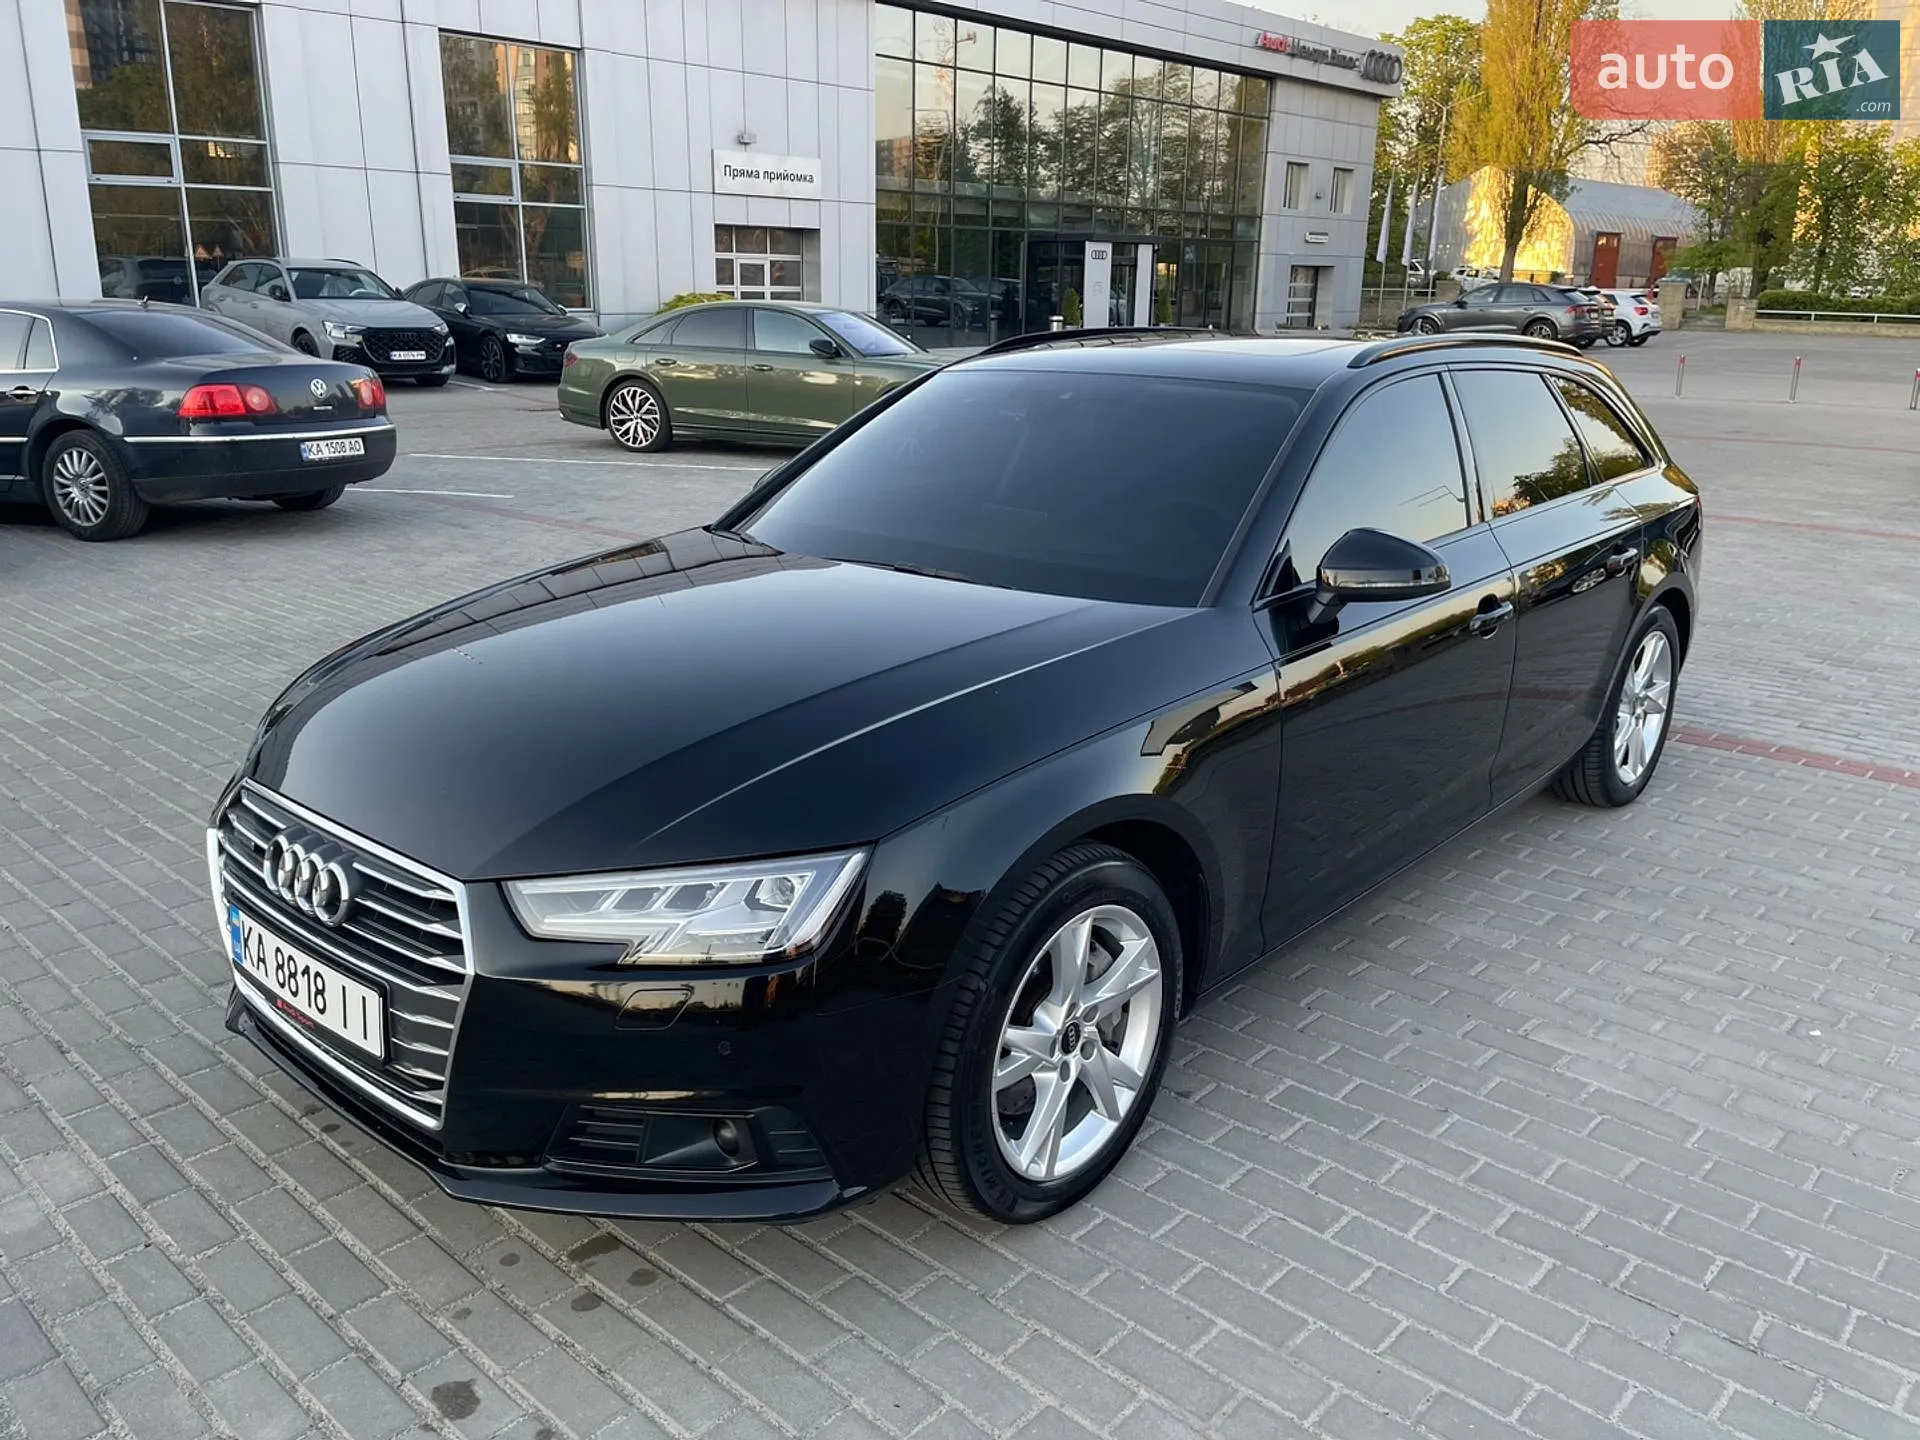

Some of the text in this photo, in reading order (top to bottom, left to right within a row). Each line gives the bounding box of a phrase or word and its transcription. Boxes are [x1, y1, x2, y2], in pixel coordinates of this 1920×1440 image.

[723, 164, 815, 184] Пряма прийомка
[306, 442, 324, 456] KA
[241, 920, 269, 979] KA
[274, 946, 327, 1015] 8818
[341, 984, 368, 1041] II
